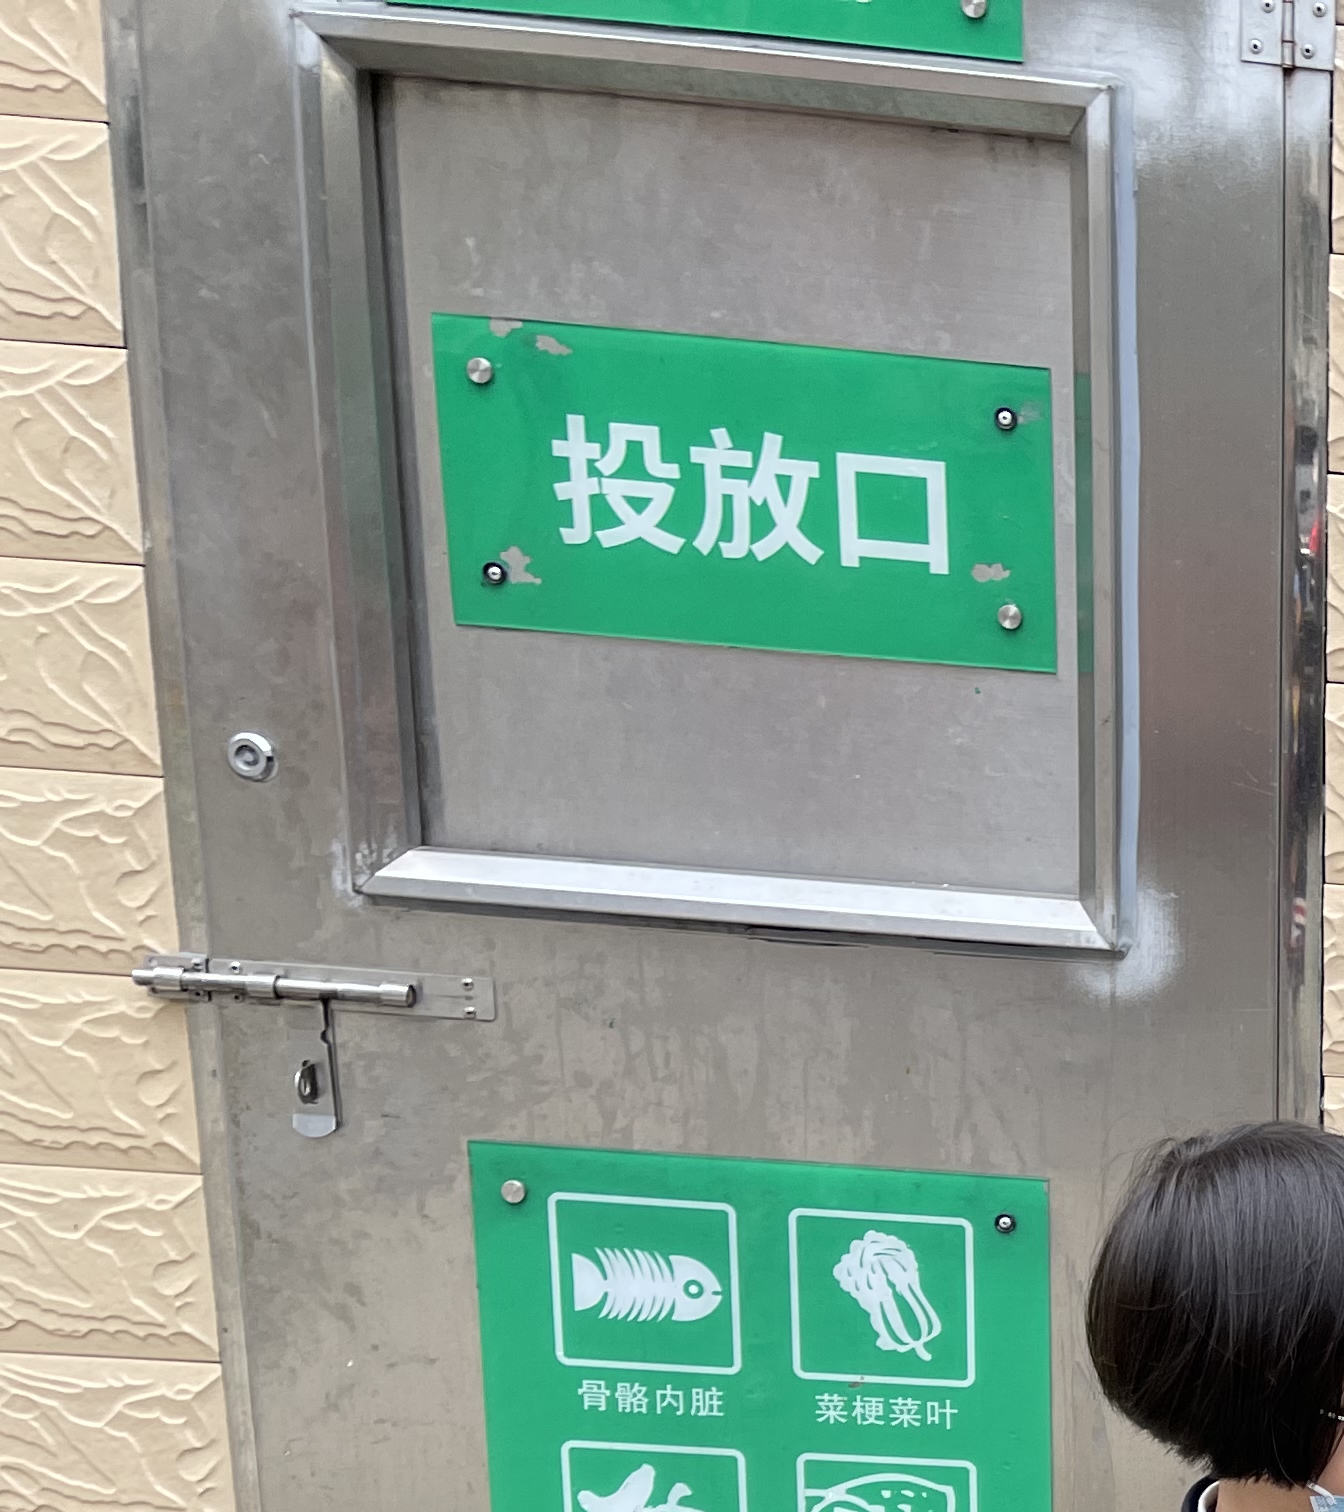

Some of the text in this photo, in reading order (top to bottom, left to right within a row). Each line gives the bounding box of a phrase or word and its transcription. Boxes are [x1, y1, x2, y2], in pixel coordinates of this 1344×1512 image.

[553, 415, 948, 574] 投放口
[577, 1379, 724, 1417] 骨骼内脏
[815, 1393, 959, 1430] 菜梗菜叶
